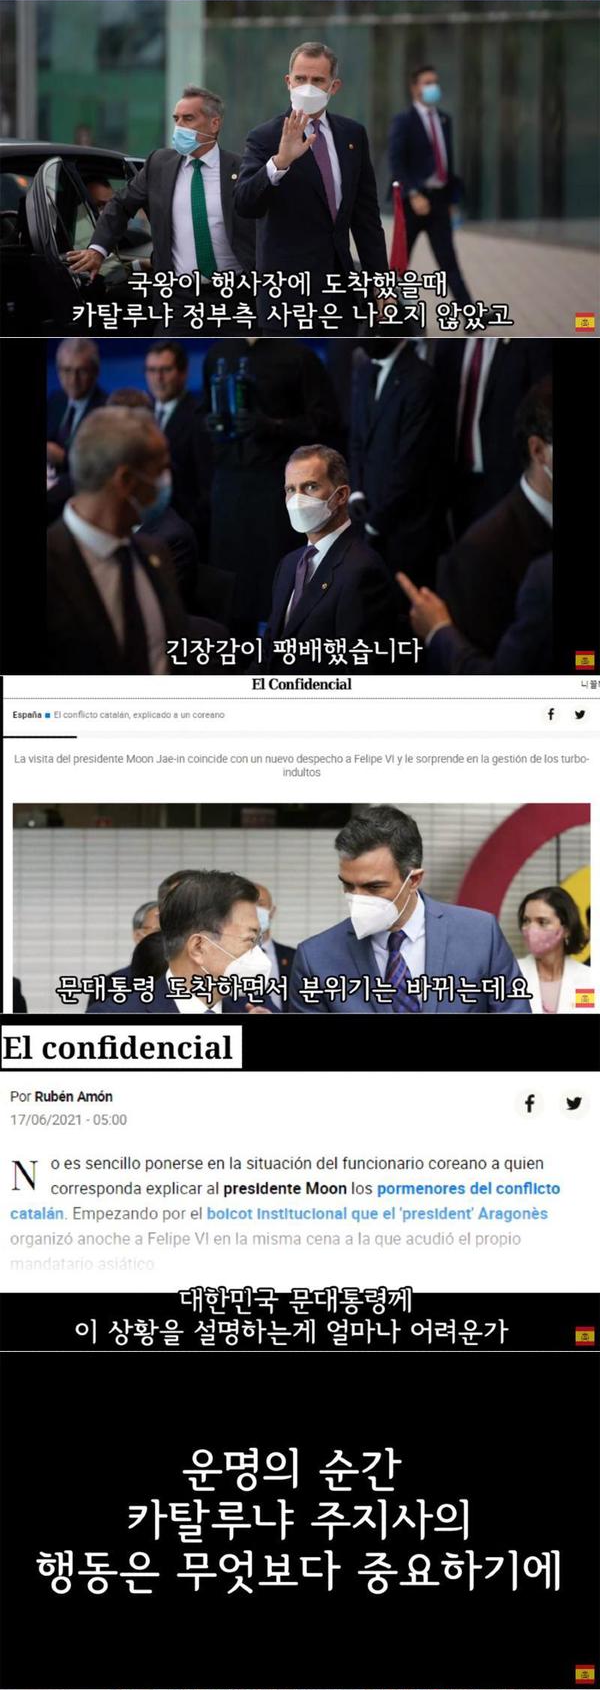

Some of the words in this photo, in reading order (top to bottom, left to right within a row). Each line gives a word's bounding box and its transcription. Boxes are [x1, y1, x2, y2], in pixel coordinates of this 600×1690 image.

[252, 678, 266, 690] El
[268, 678, 352, 690] Confidencial
[2, 1034, 34, 1060] El
[41, 1034, 234, 1060] confidencial
[10, 1090, 32, 1103] Por
[34, 1089, 74, 1103] Rubén
[76, 1089, 113, 1103] Amón
[10, 1114, 82, 1126] 17/06/2021
[93, 1114, 128, 1126] 05:00
[50, 1158, 61, 1170] o
[63, 1158, 81, 1170] es
[85, 1156, 141, 1170] sencillo
[145, 1158, 204, 1173] ponerse
[207, 1158, 225, 1170] en
[229, 1156, 242, 1170] la
[246, 1156, 312, 1170] situación
[316, 1156, 338, 1170] del
[342, 1156, 425, 1170] funcionario
[428, 1158, 488, 1170] coreano
[491, 1159, 500, 1170] a
[503, 1156, 544, 1173] quien
